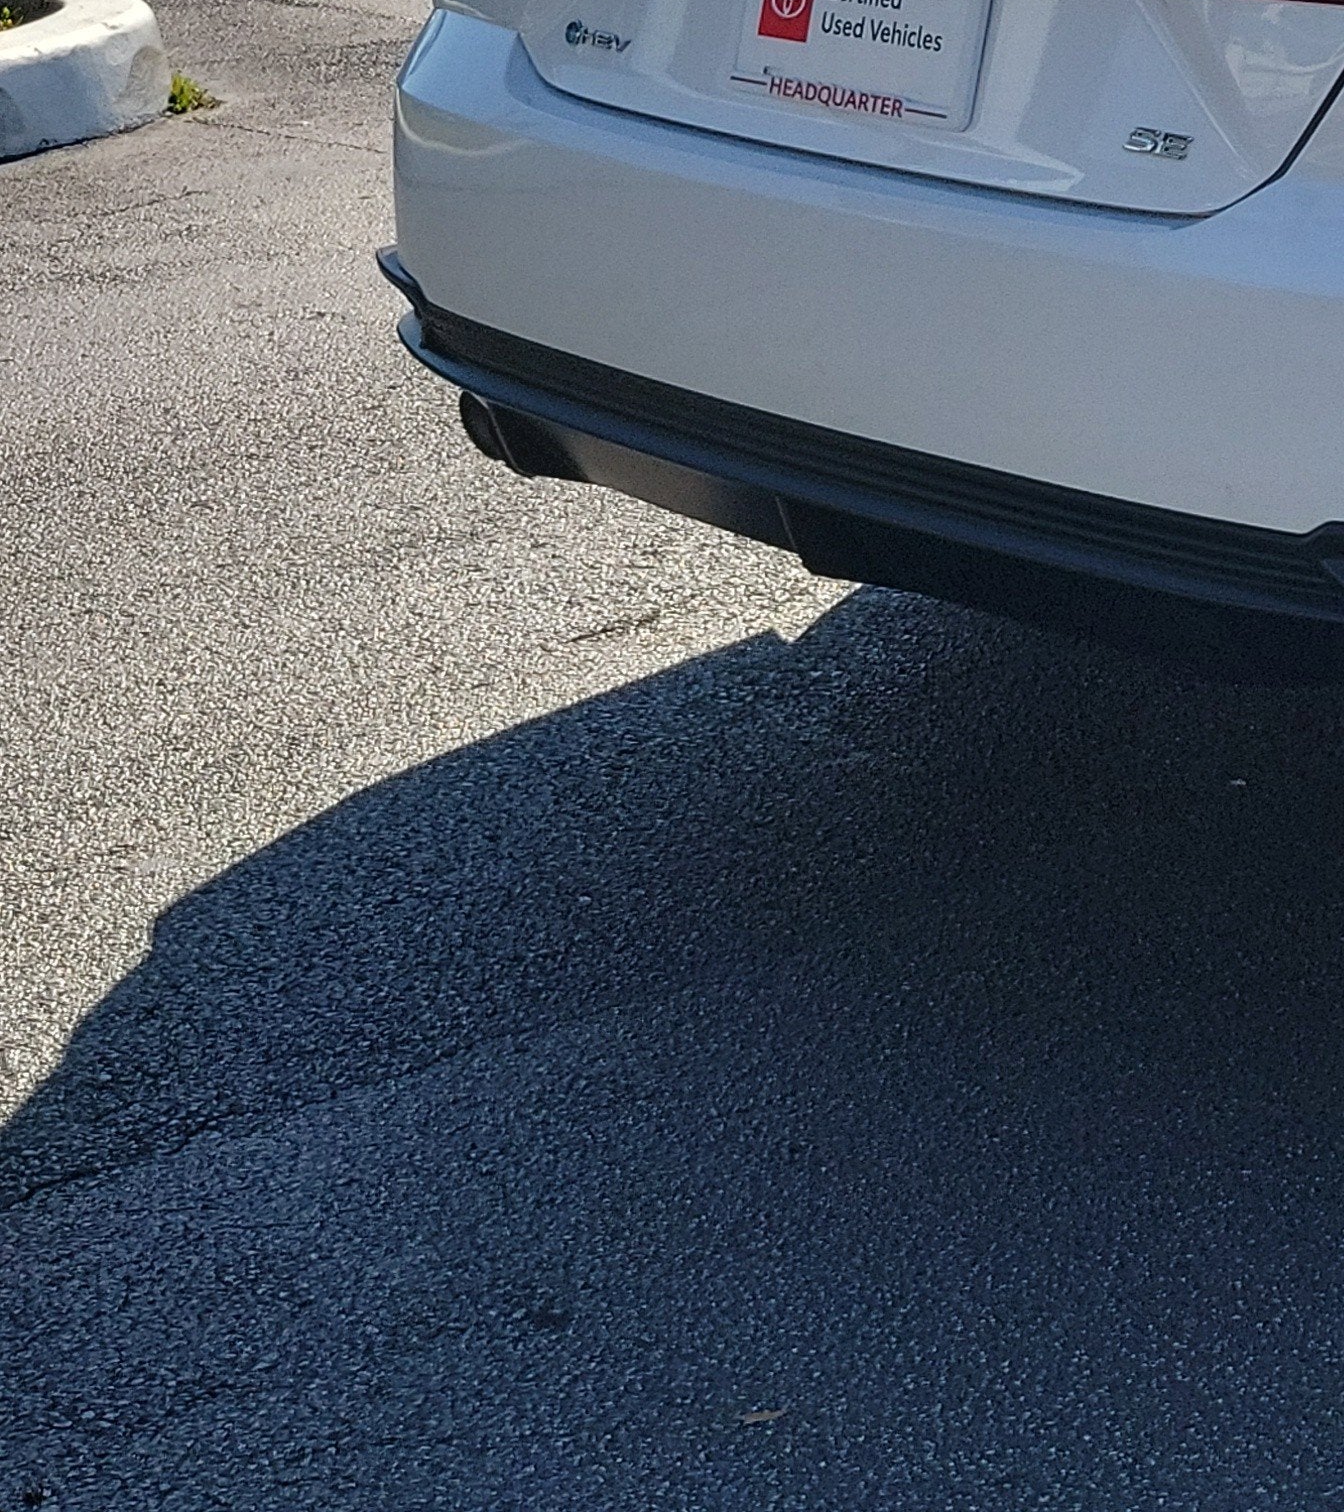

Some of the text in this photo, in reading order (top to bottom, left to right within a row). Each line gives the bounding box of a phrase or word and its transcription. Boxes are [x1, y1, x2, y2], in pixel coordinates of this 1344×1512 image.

[821, 11, 943, 52] Used Vehicles
[768, 76, 904, 118] HEADQUARTER
[1122, 126, 1194, 160] SE
